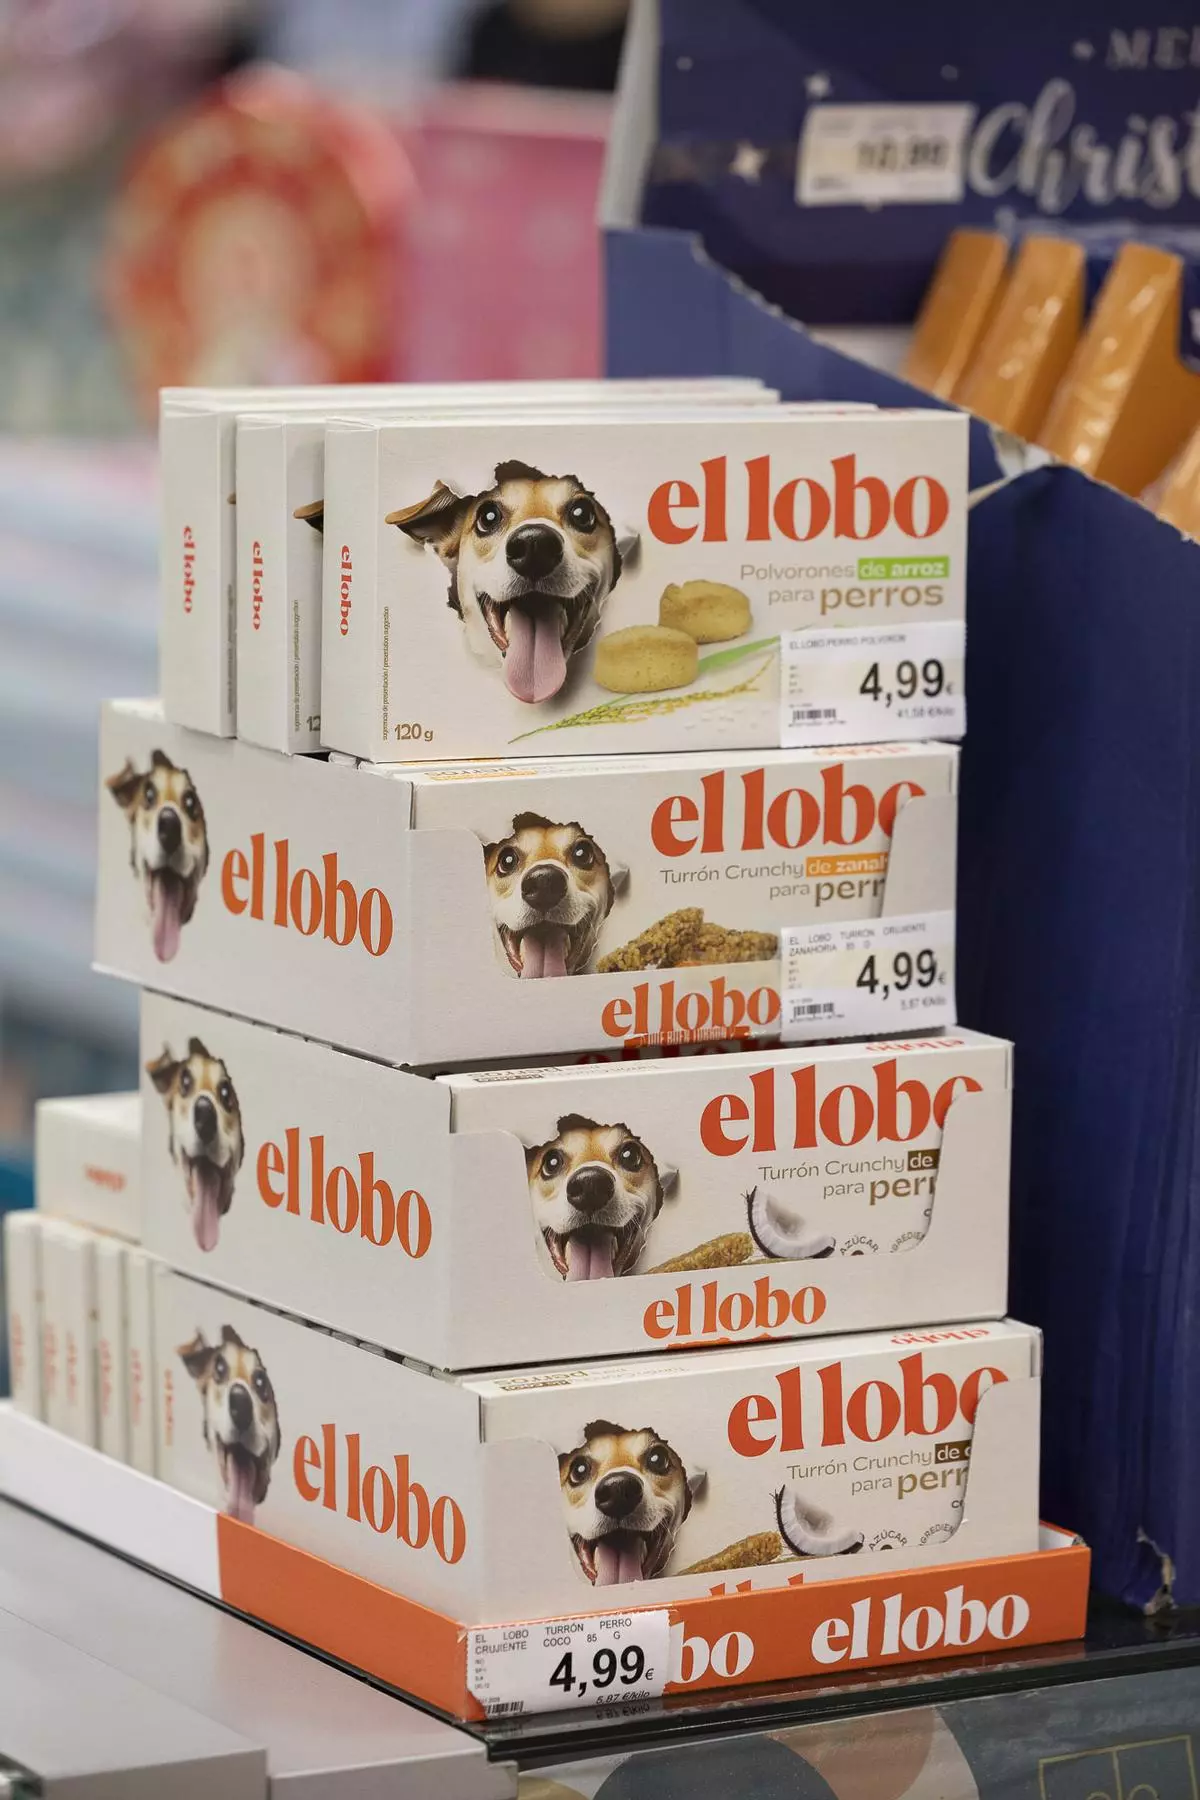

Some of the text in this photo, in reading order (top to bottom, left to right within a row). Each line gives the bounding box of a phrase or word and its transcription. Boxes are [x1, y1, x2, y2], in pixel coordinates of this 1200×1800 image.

[648, 452, 949, 545] el lobo
[252, 541, 264, 631] el lobo
[339, 545, 353, 637] el lobo
[740, 561, 945, 580] Polvorones de arroz
[768, 584, 944, 615] para perros
[306, 715, 320, 732] 12
[395, 723, 422, 740] 120
[651, 769, 725, 857] el
[221, 832, 393, 957] el lobo
[660, 863, 719, 884] Turrón
[725, 860, 804, 880] Crunchy
[808, 859, 831, 875] de
[769, 883, 810, 900] para
[602, 976, 781, 1038] el lobo
[700, 1068, 776, 1157] el
[758, 1152, 933, 1181] Turrón Crunchy de
[823, 1181, 865, 1200] para
[256, 1127, 432, 1259] el lobo
[643, 1276, 827, 1339] el lobo
[727, 1366, 805, 1457] el
[787, 1459, 848, 1480] Turrón
[853, 1450, 932, 1471] Crunchy
[937, 1445, 960, 1462] de
[851, 1477, 893, 1496] para
[293, 1423, 466, 1564] el lobo
[869, 1529, 907, 1551] AZÚCAR
[475, 1618, 632, 1643] EL LOBO TURRÓN PERRO
[475, 1631, 621, 1655] CRUJIENTE COCO 85 G
[811, 1585, 1030, 1664] el lobo
[669, 1622, 754, 1684] bo
